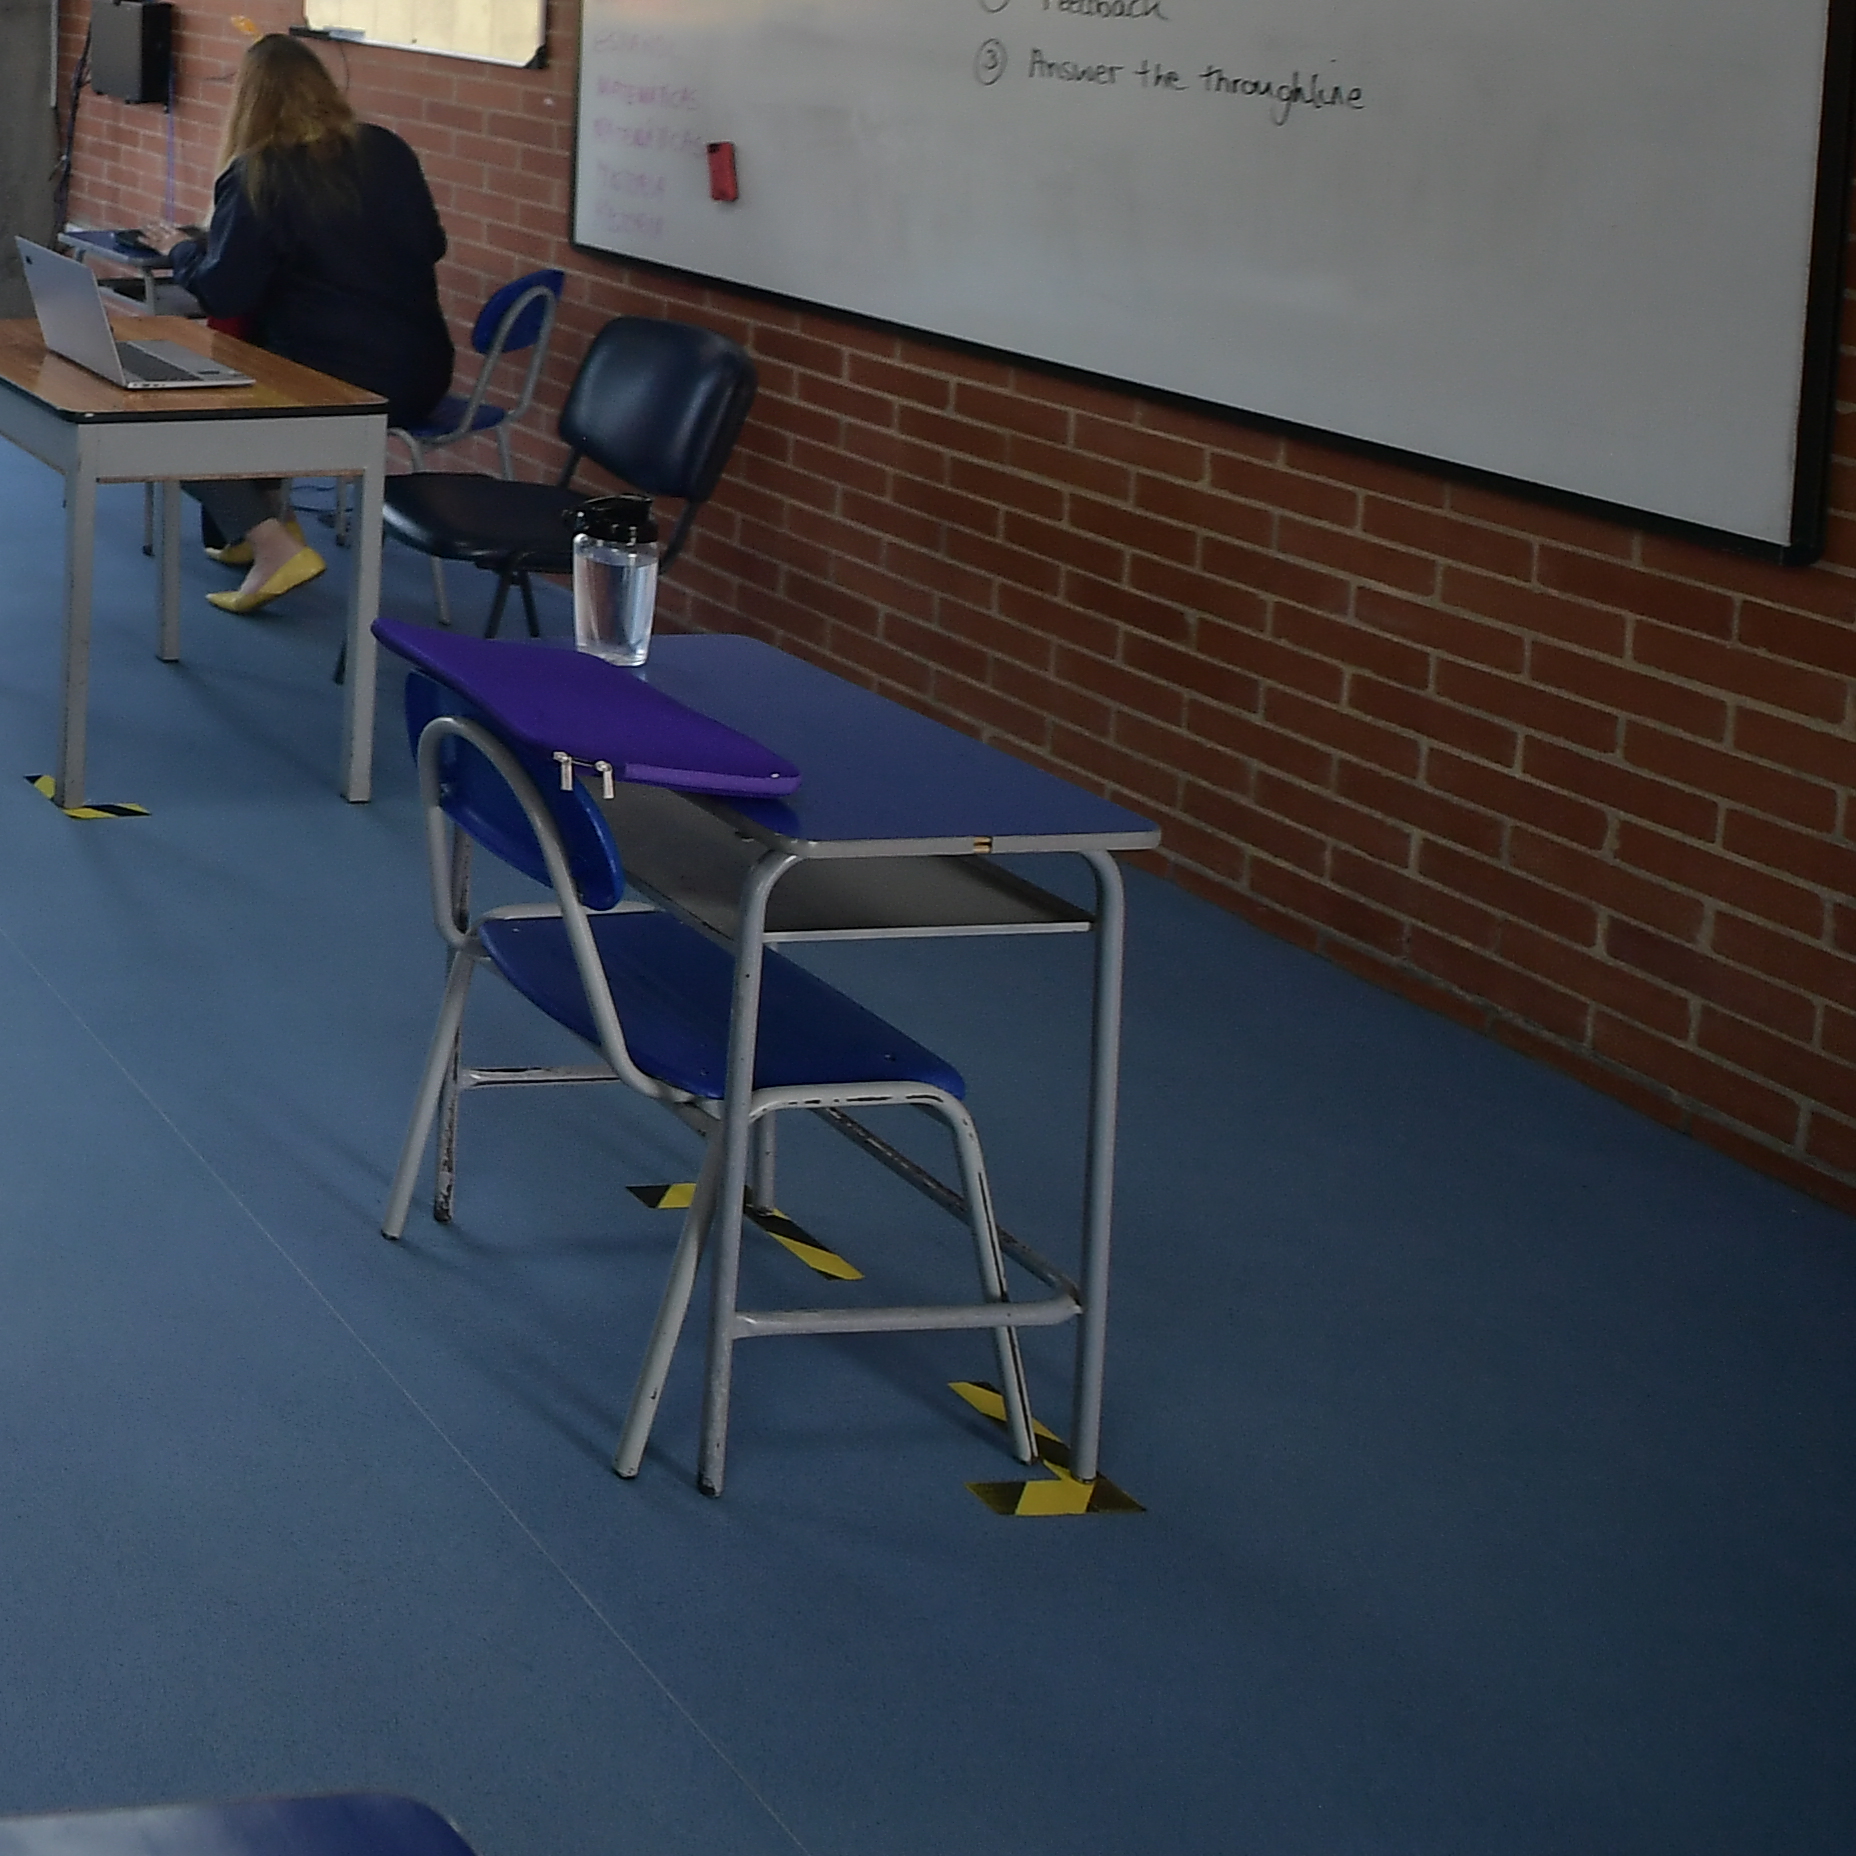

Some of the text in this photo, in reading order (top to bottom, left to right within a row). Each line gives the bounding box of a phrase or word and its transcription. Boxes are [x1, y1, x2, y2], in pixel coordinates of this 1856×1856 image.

[1029, 48, 1124, 85] Answer
[1134, 59, 1188, 92] the
[1199, 59, 1366, 125] throughline
